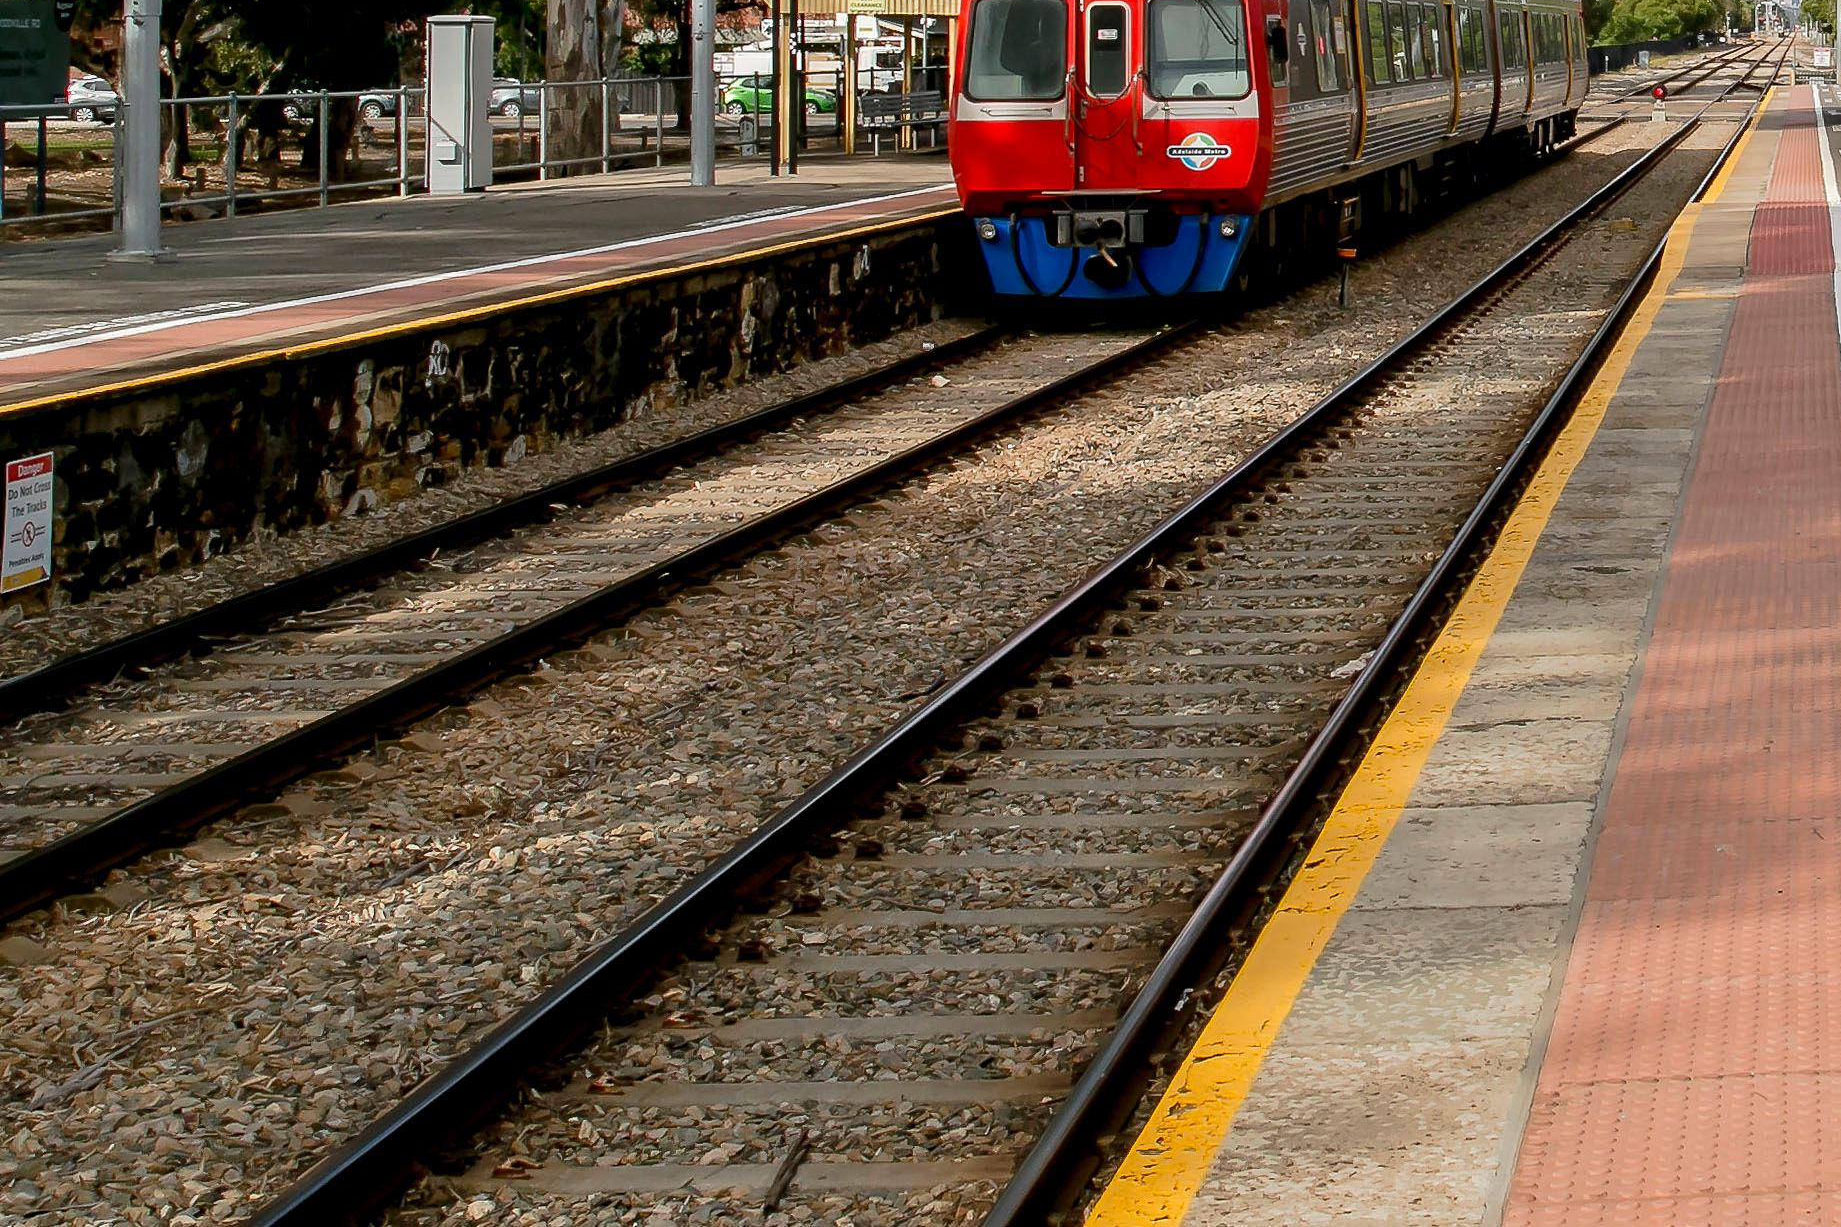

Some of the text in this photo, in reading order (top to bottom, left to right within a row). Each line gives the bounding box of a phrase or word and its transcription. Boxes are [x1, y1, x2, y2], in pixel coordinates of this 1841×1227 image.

[18, 462, 45, 478] Danger
[8, 481, 51, 501] Do Not Cross
[11, 499, 47, 518] The Tracks
